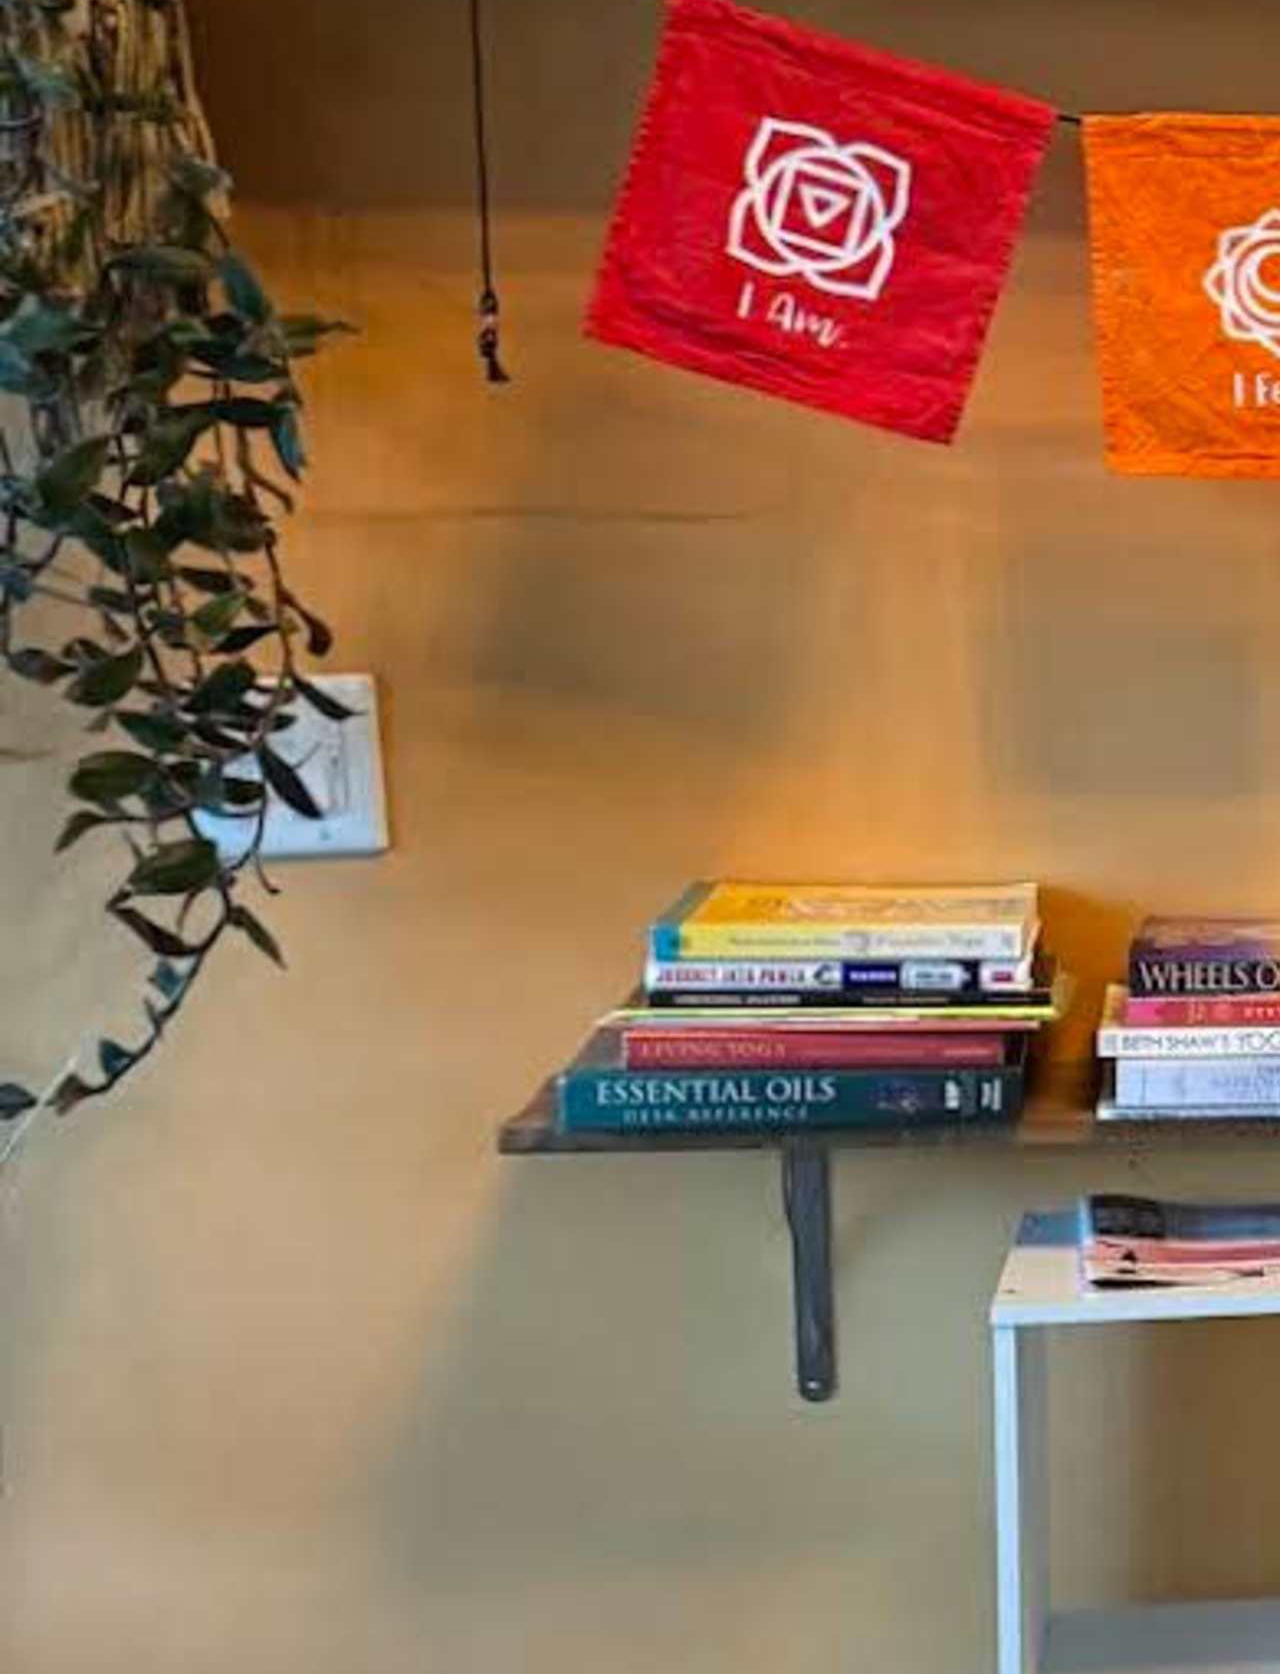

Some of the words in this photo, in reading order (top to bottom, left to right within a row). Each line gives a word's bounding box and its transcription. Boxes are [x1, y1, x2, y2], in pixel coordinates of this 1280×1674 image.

[737, 282, 754, 318] I
[1232, 371, 1245, 408] I
[1139, 960, 1250, 991] WHEELS
[596, 1078, 758, 1105] ESSENTIAL
[766, 1077, 837, 1102] OILS
